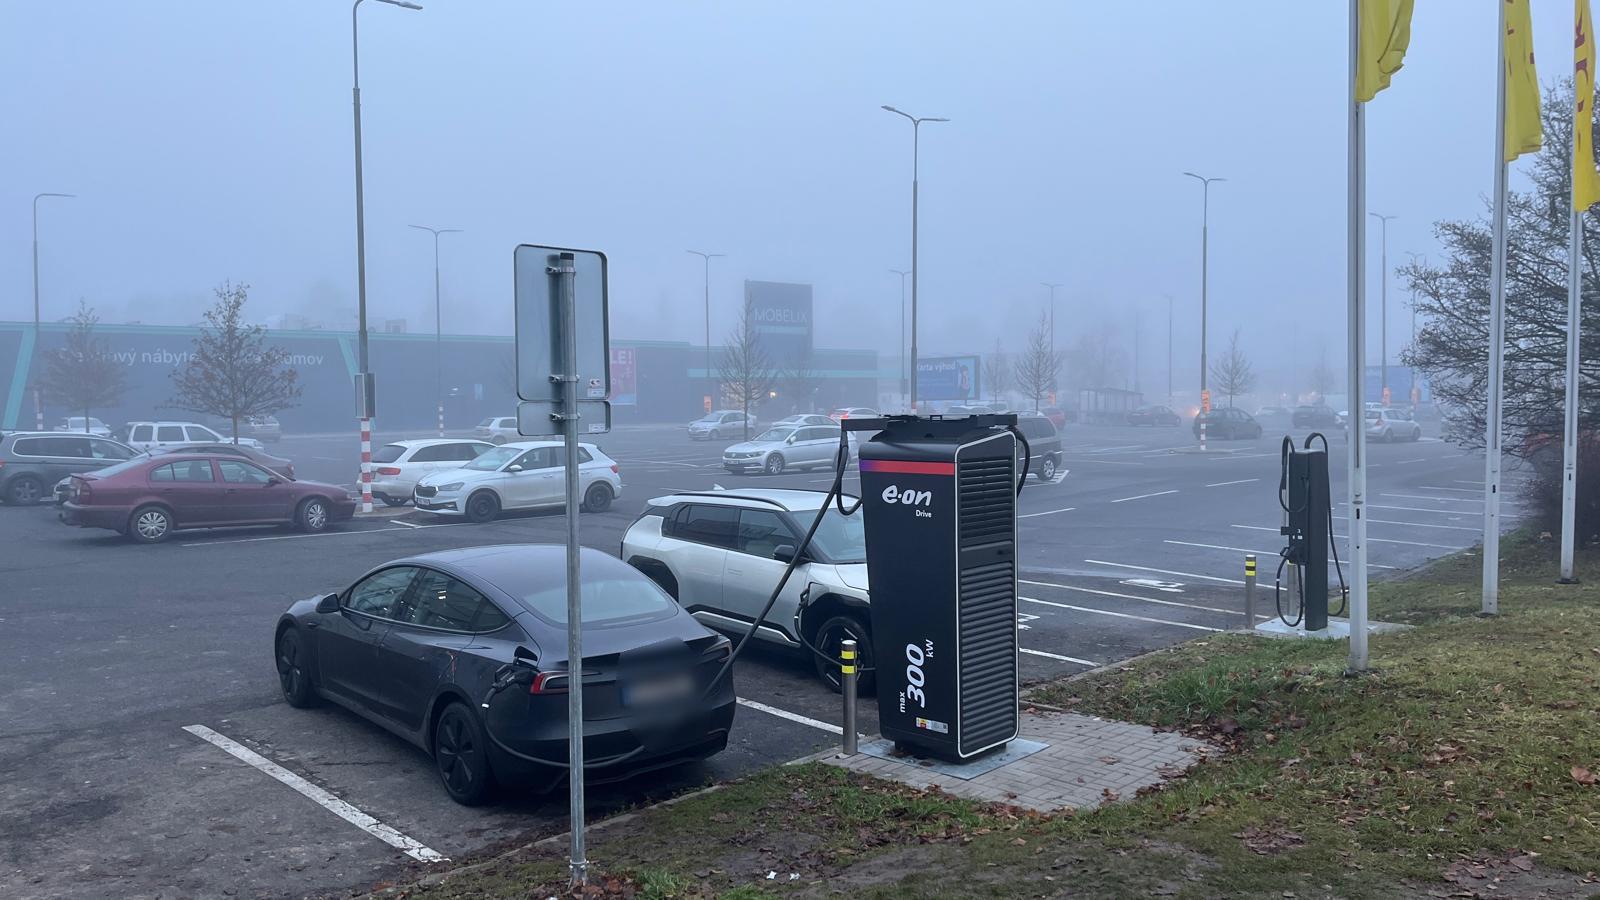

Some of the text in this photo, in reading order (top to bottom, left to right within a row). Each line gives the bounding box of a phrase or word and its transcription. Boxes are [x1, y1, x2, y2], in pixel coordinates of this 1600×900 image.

[142, 347, 206, 367] nábyte
[915, 509, 932, 518] Drive
[925, 639, 934, 658] kW
[906, 643, 926, 709] 300
